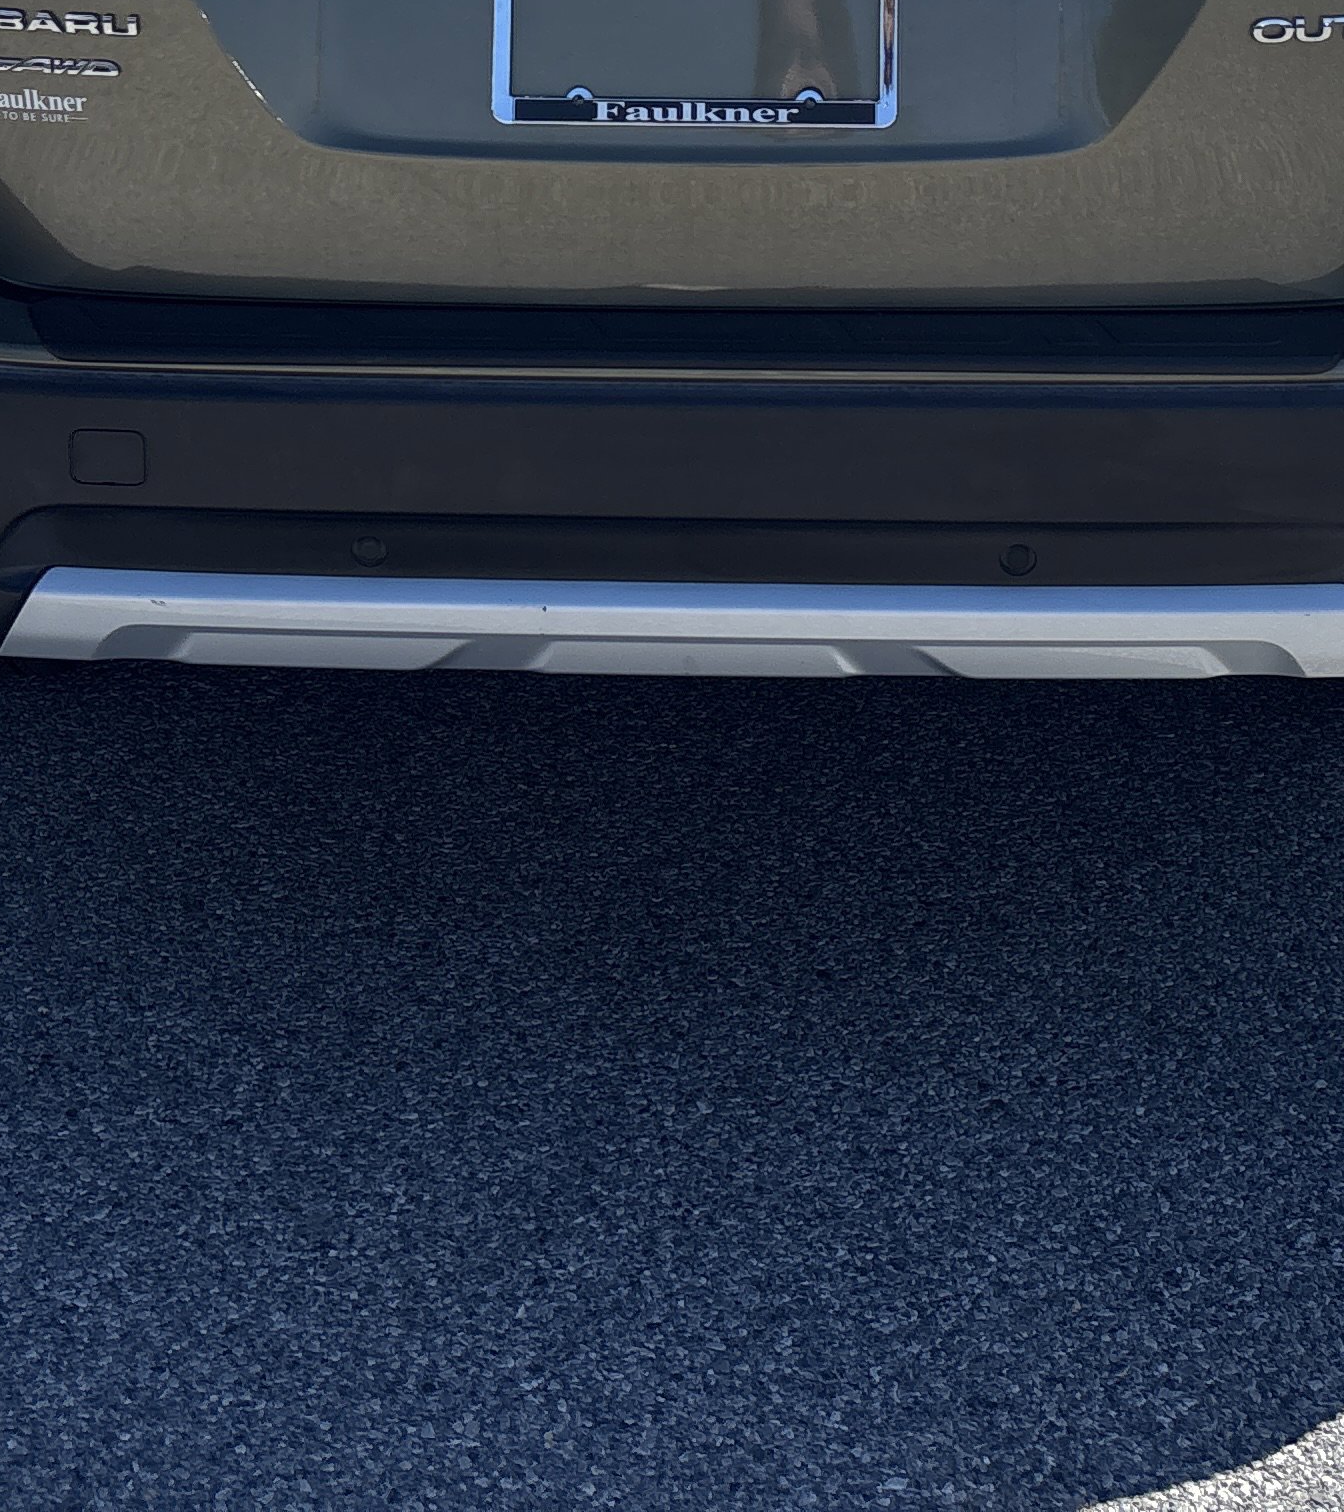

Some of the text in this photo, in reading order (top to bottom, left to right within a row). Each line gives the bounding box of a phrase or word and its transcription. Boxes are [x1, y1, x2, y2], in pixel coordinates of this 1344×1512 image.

[1, 111, 71, 123] TO BE SURE
[591, 100, 800, 124] Faulkner
